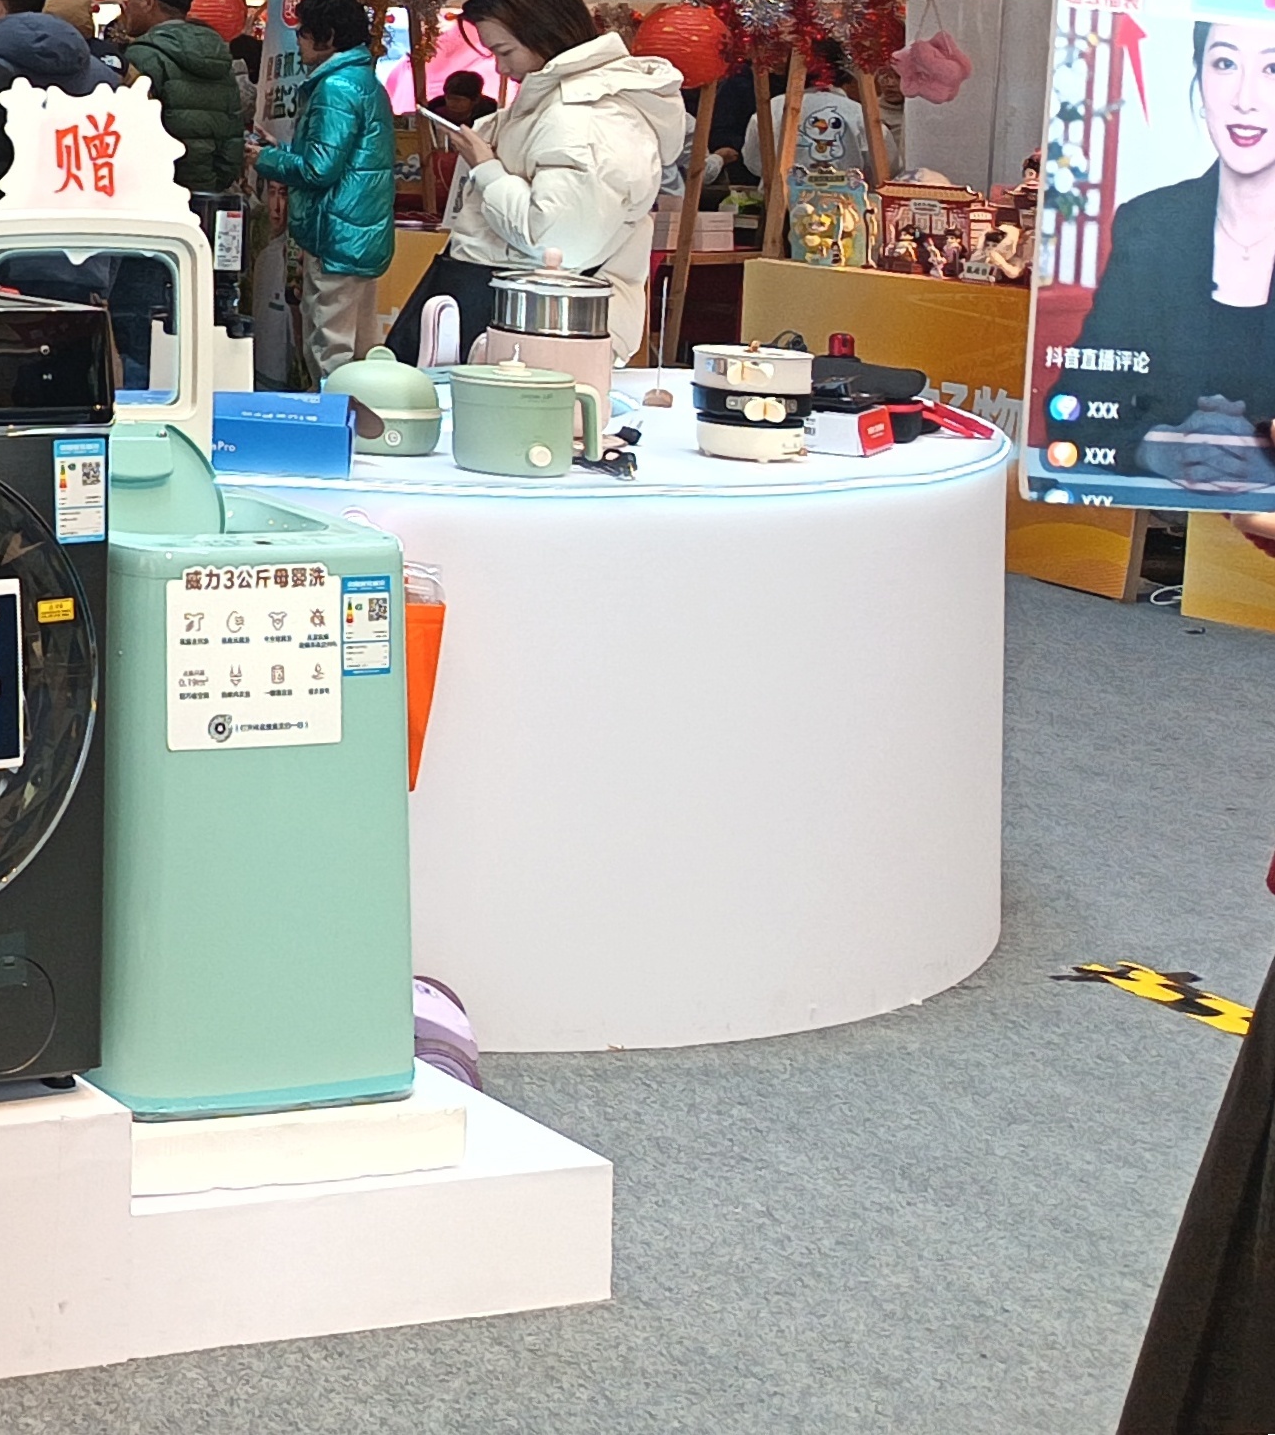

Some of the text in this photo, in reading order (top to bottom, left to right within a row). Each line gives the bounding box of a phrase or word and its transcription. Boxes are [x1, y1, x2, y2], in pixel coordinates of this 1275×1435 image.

[54, 112, 122, 198] 赠
[1045, 346, 1150, 374] 抖音直播评论
[1087, 401, 1119, 420] XXX
[1083, 447, 1116, 465] XXX
[185, 567, 325, 591] 威力3公斤母婴洗
